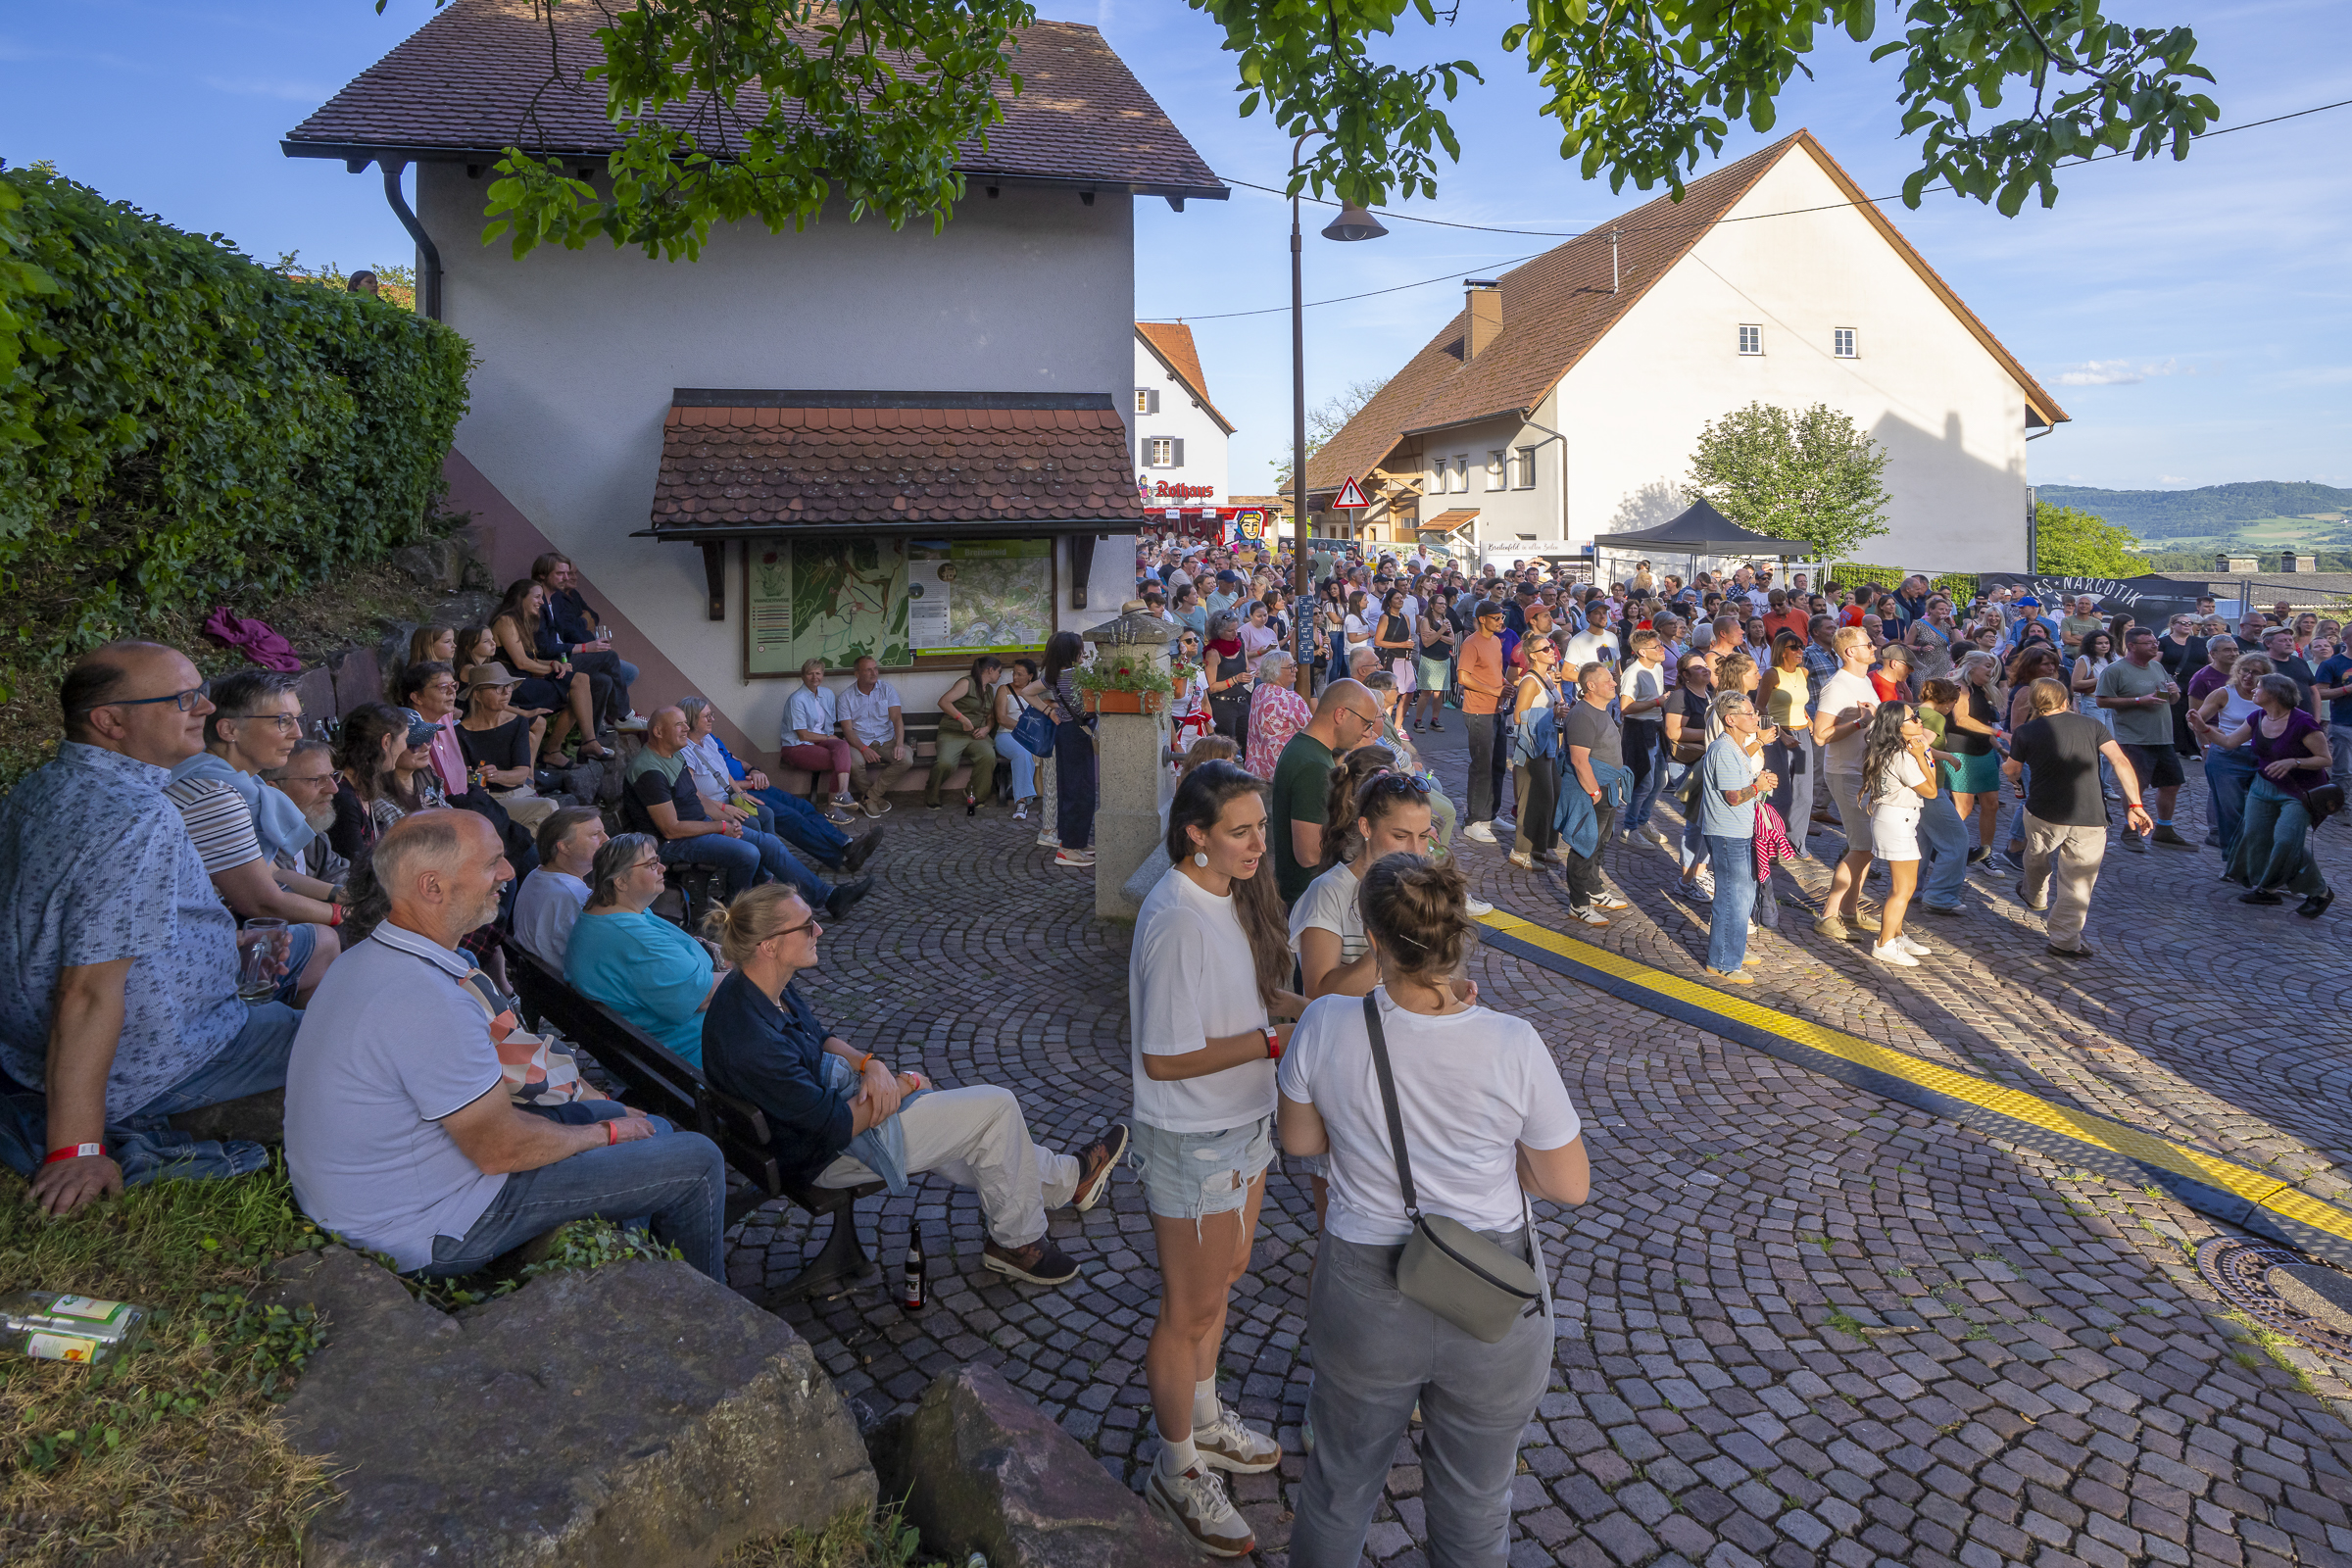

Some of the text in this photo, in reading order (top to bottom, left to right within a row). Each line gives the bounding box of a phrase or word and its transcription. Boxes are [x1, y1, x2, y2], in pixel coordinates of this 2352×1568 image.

[1155, 480, 1213, 500] Rothaus
[964, 548, 1006, 557] Breitenfeld
[2063, 576, 2143, 609] NARCOTIK
